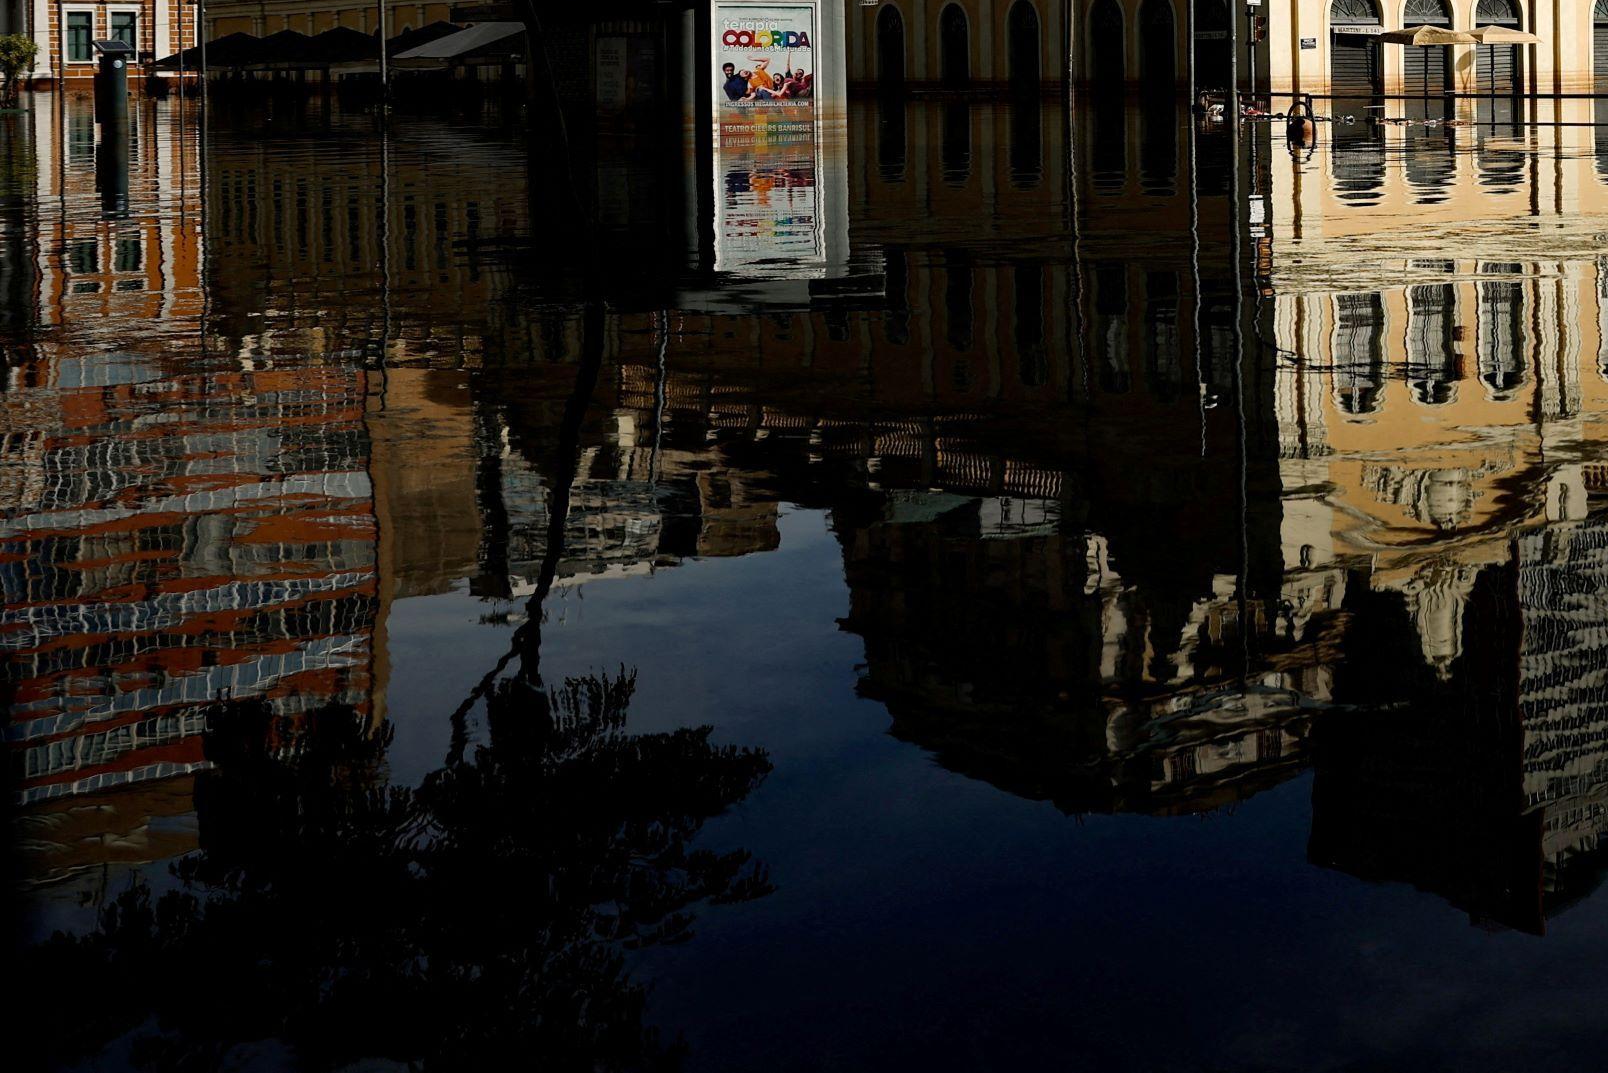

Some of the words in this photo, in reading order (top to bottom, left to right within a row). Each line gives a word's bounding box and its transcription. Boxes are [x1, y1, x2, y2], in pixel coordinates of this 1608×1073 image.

[723, 19, 778, 32] terapia
[722, 30, 810, 48] COLORIDA
[724, 125, 750, 133] TEATRO
[778, 124, 811, 133] BANRISUL
